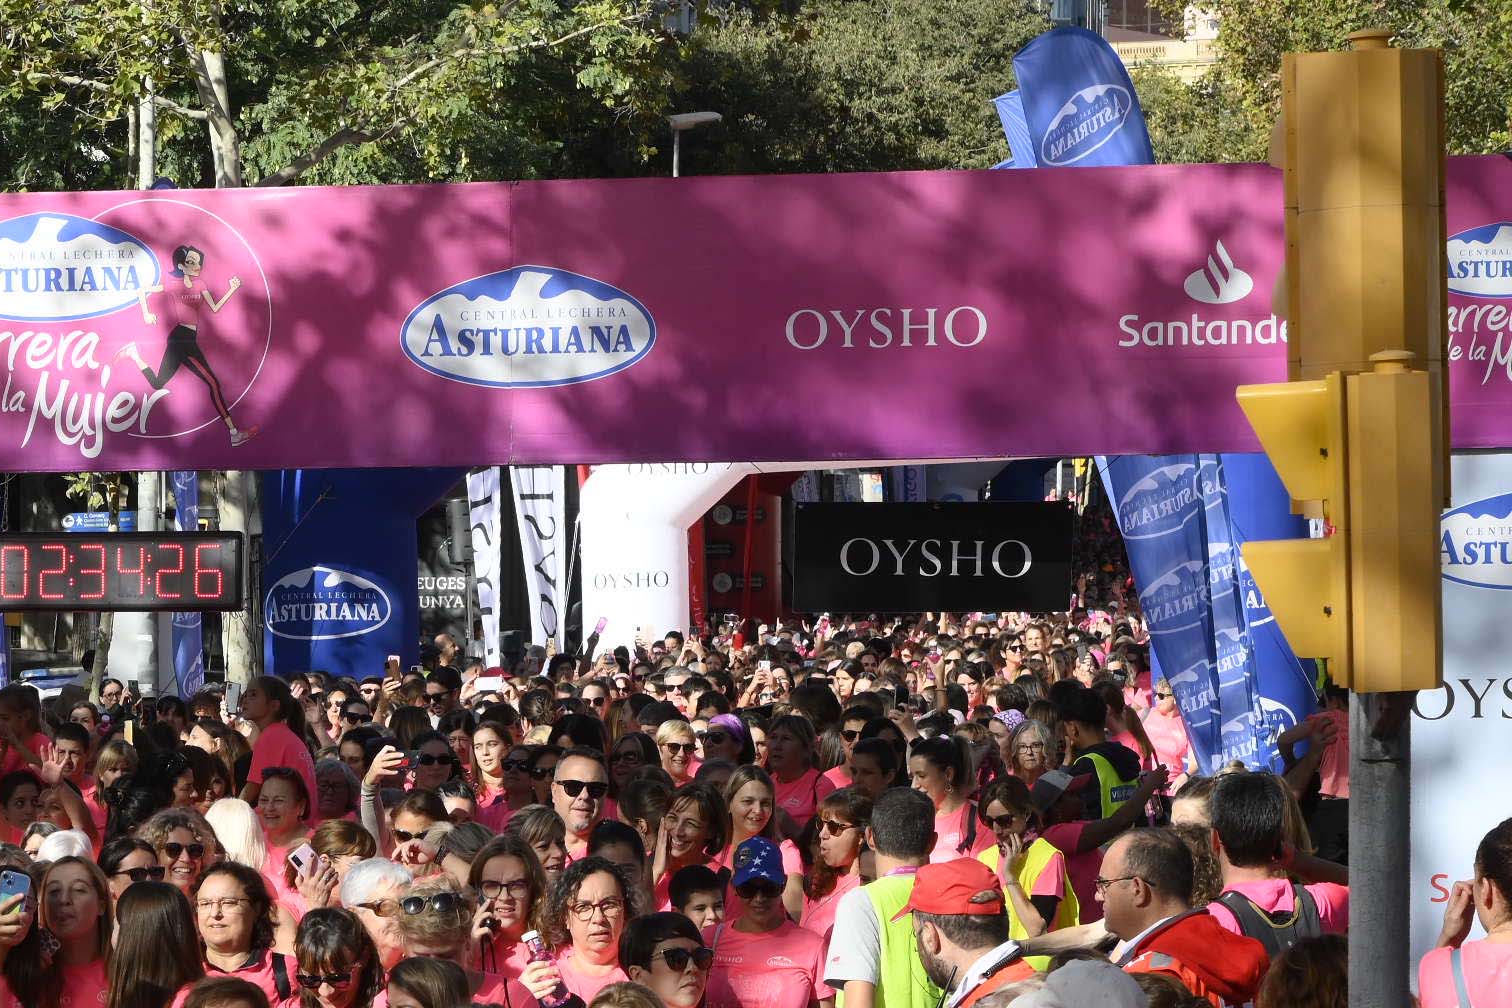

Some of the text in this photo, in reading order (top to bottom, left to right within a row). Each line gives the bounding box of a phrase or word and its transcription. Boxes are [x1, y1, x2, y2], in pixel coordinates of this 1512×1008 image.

[63, 248, 135, 259] LECHERA
[460, 306, 628, 321] CENTRAL LECHERA
[785, 306, 988, 350] OYSHO
[420, 313, 637, 357] ASTURIANA
[0, 374, 26, 413] la
[21, 365, 170, 459] Mujer
[840, 537, 1033, 578] OYSHO
[1441, 529, 1512, 565] ASTU
[0, 544, 223, 599] 02:34:26
[594, 570, 670, 591] OYSHO
[269, 598, 382, 626] ASTURIANA
[328, 591, 377, 601] LECHERA
[419, 595, 465, 609] UNYA
